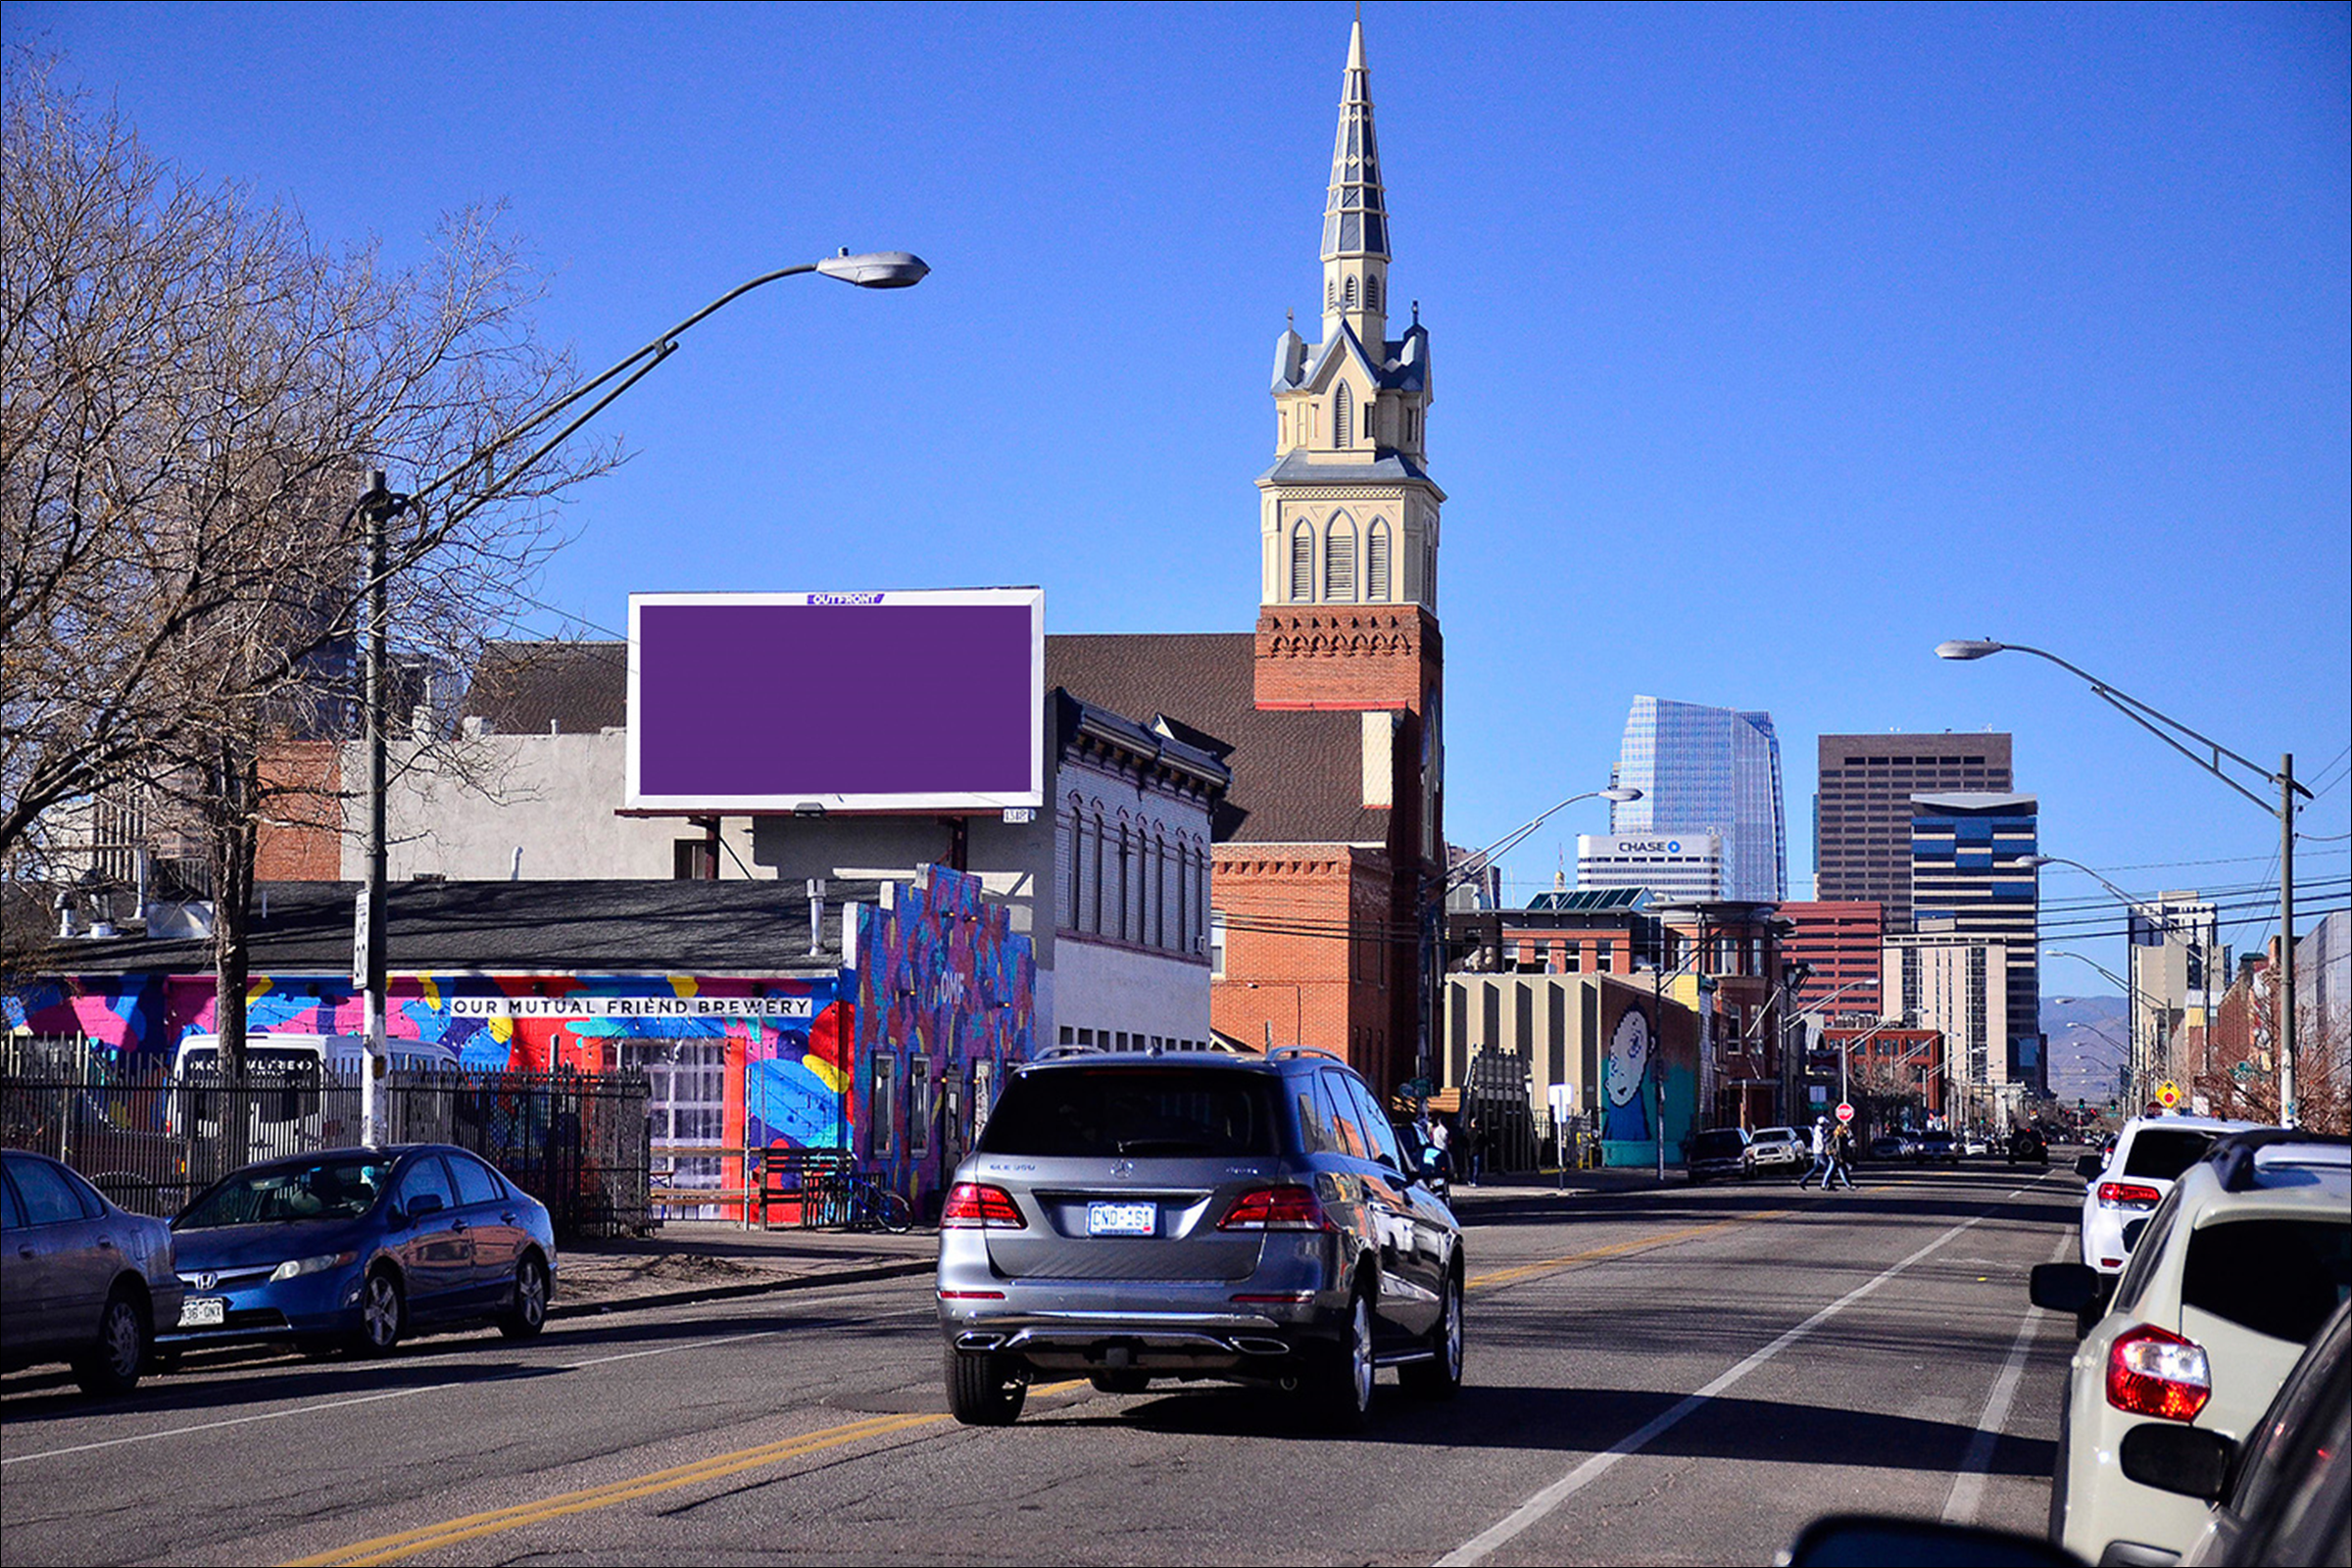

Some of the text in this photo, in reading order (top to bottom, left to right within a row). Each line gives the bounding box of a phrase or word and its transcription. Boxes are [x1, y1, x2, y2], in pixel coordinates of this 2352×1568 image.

[811, 594, 878, 605] OUTFRONT
[1618, 842, 1666, 853] CHASE
[941, 971, 965, 1004] OMF
[453, 999, 809, 1014] OUR MUTUAL FRIEND BREWERY
